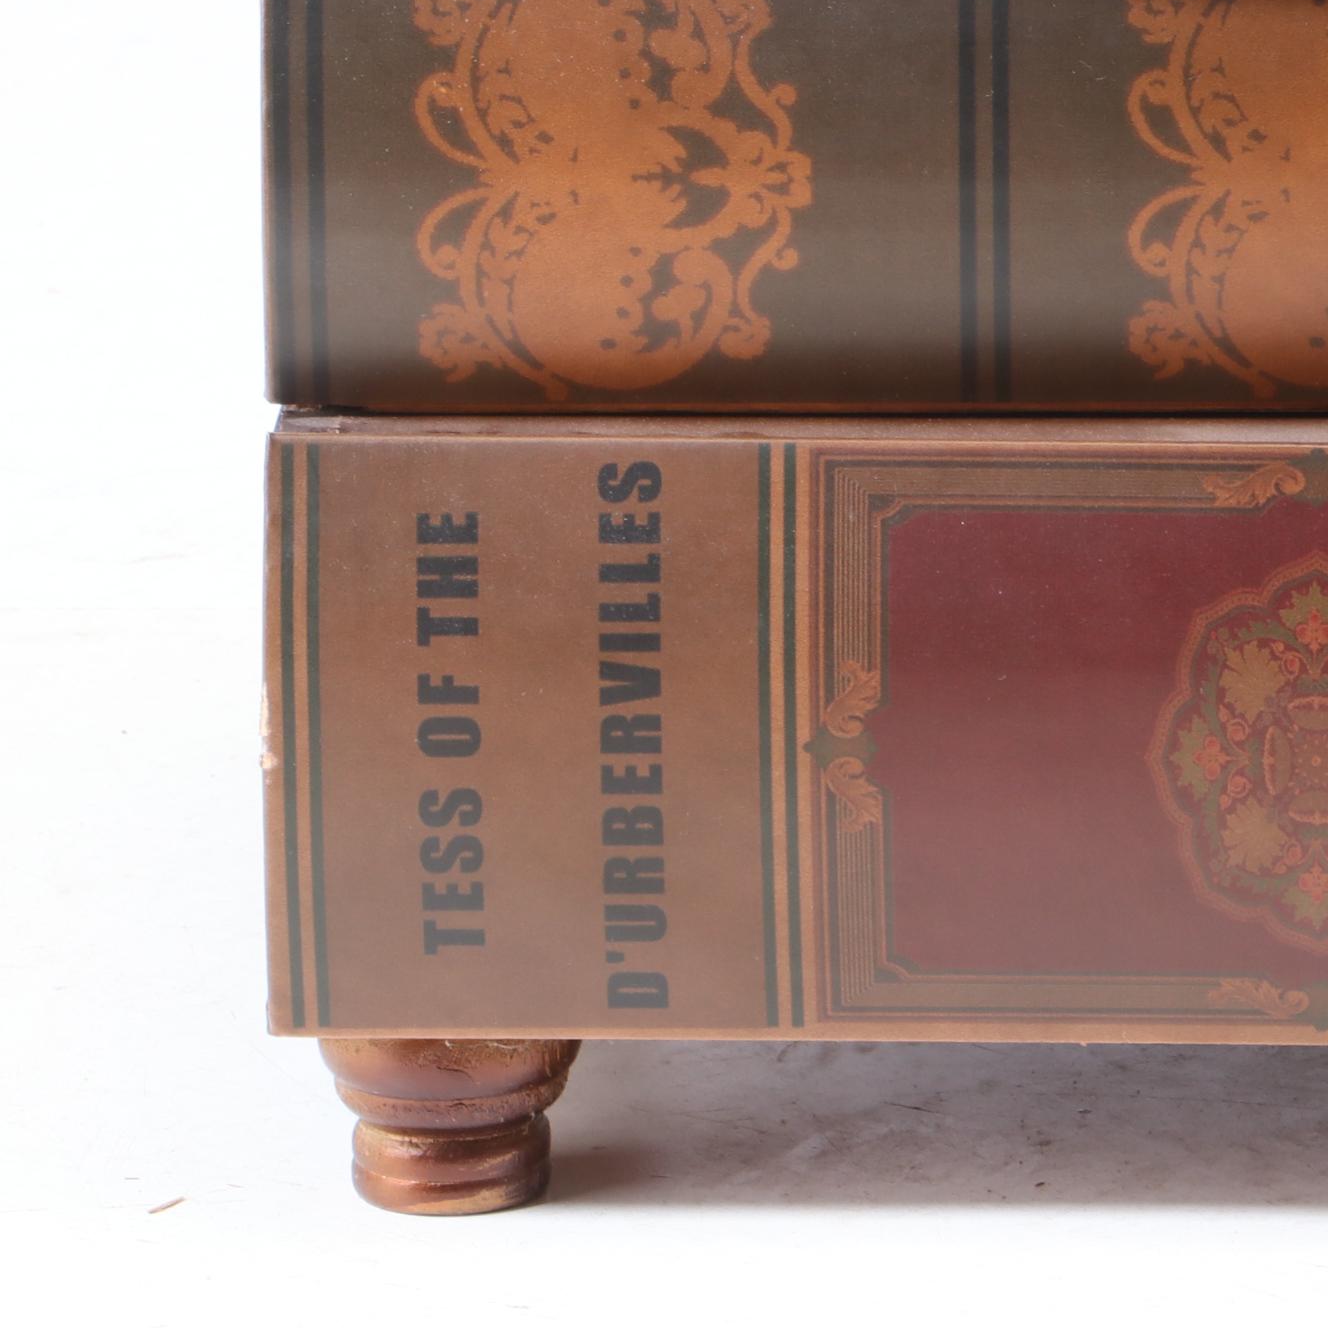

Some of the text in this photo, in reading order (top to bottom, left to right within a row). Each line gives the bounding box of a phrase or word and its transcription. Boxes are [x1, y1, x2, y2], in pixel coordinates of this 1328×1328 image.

[416, 510, 486, 955] TESS OF THE
[597, 459, 669, 1010] D'URBERVILLES
